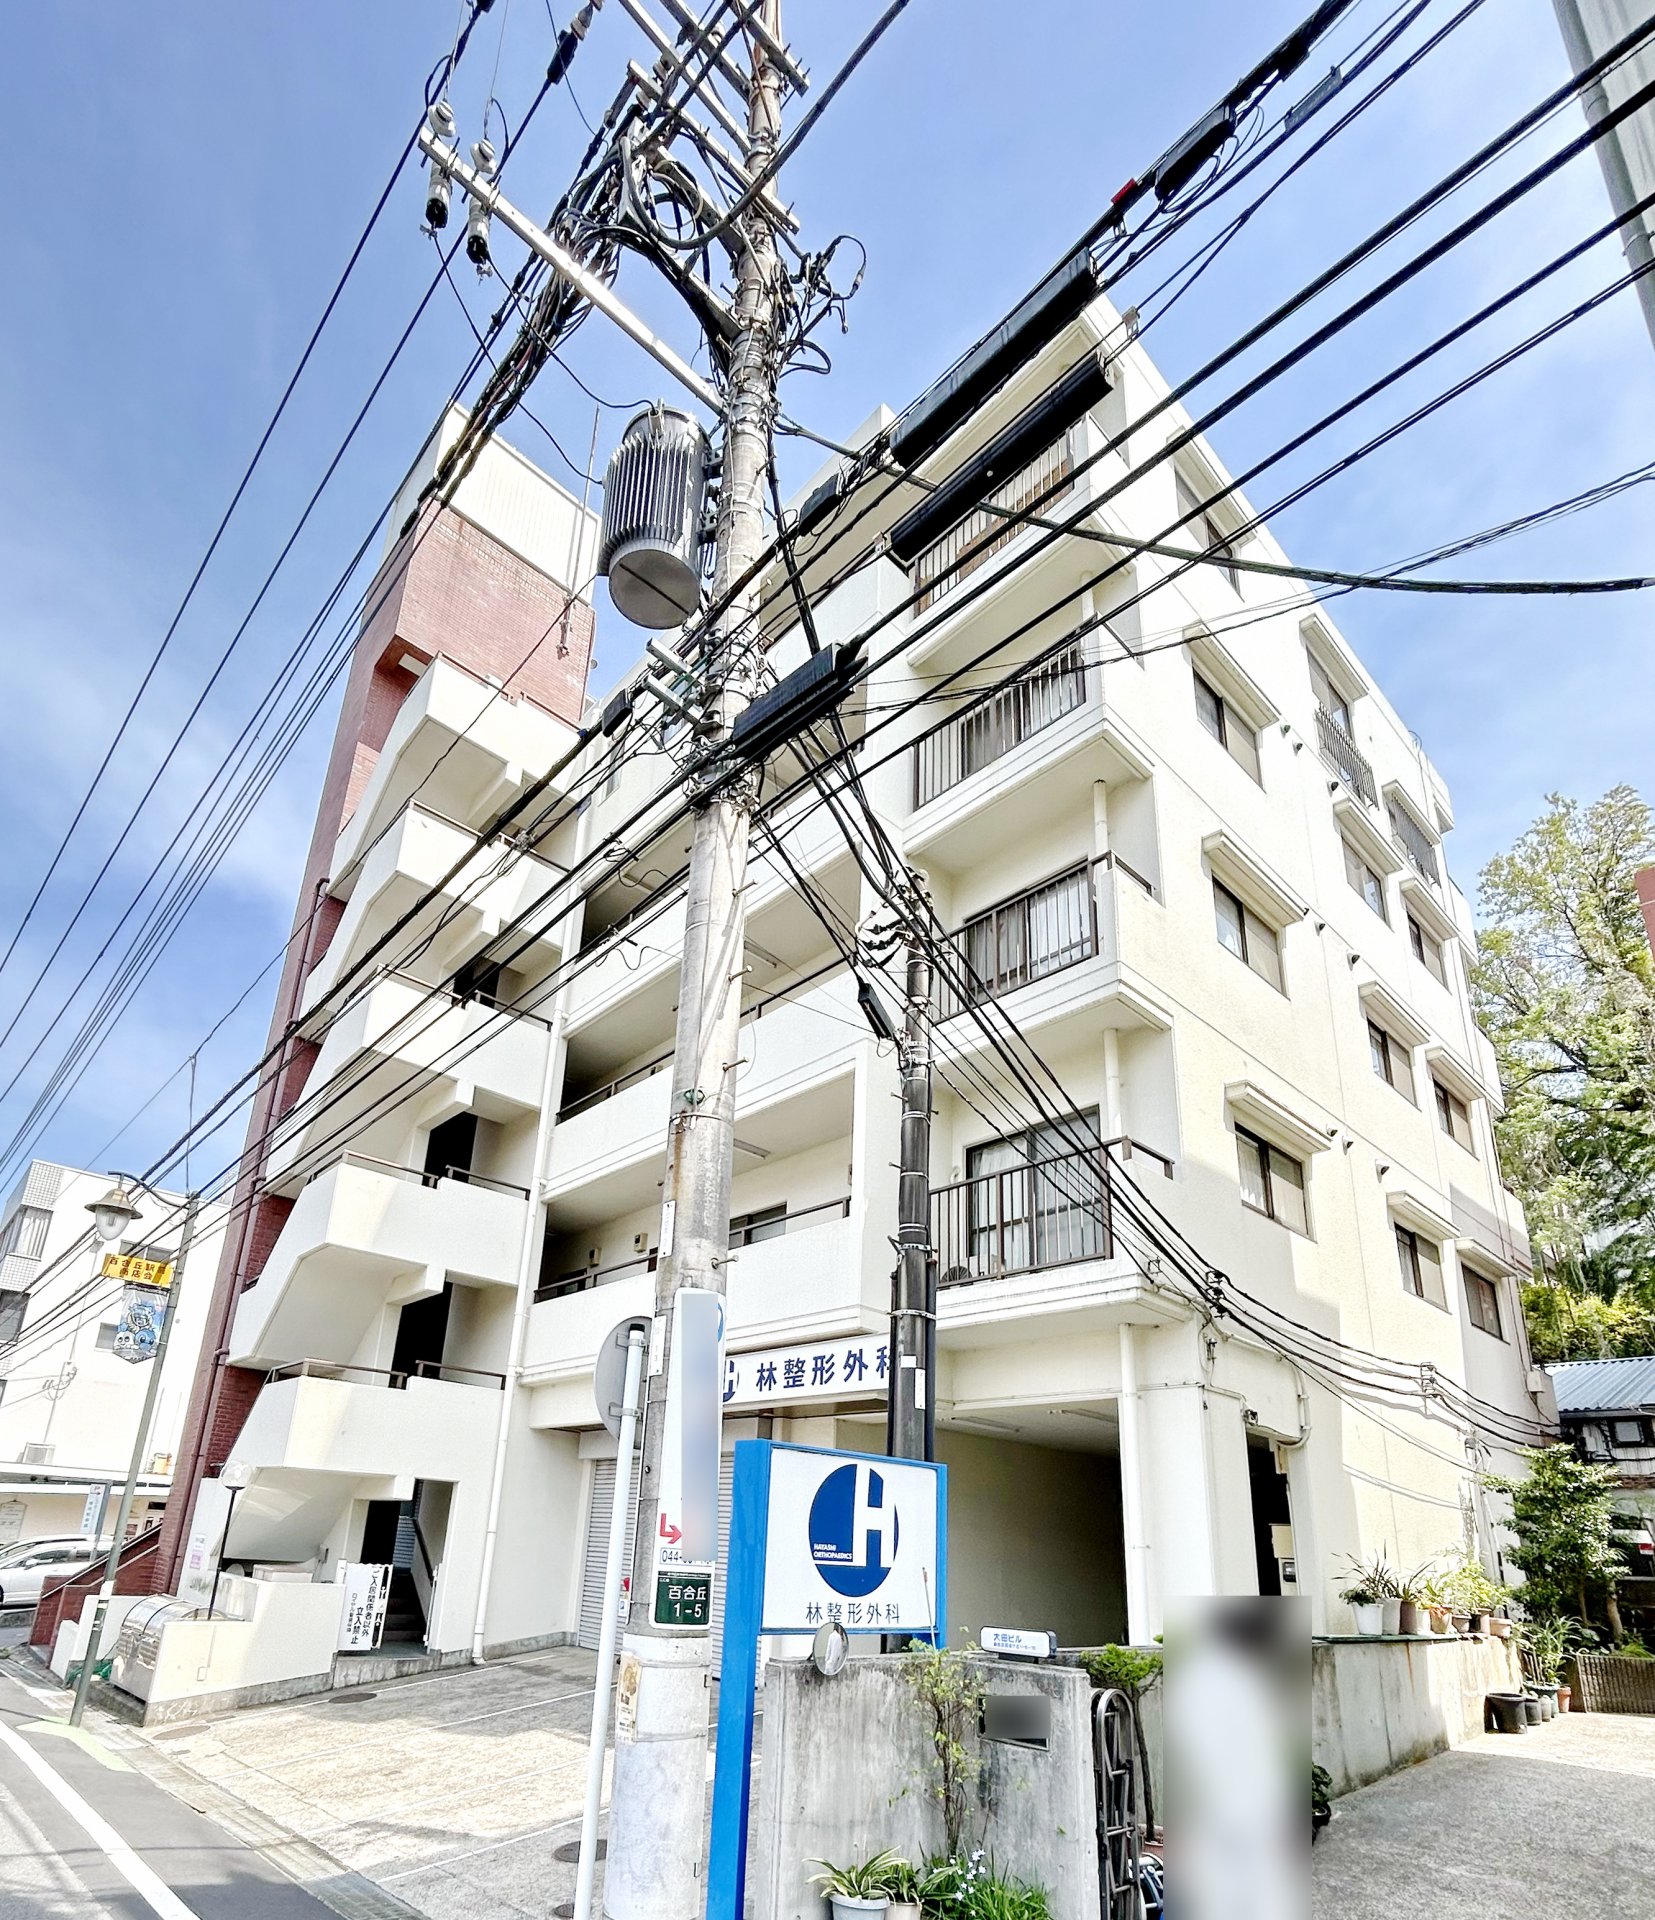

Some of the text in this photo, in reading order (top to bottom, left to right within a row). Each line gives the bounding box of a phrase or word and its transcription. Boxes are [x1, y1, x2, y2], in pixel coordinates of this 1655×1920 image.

[755, 1345, 890, 1393] 林整形外科
[813, 1543, 837, 1552] HAYASHI
[813, 1551, 853, 1560] ORTHOPAEDICS
[668, 1585, 707, 1600] 百合丘
[673, 1602, 702, 1618] 1-5
[805, 1601, 900, 1625] 林整形外科
[350, 1606, 364, 1645] 立入禁止
